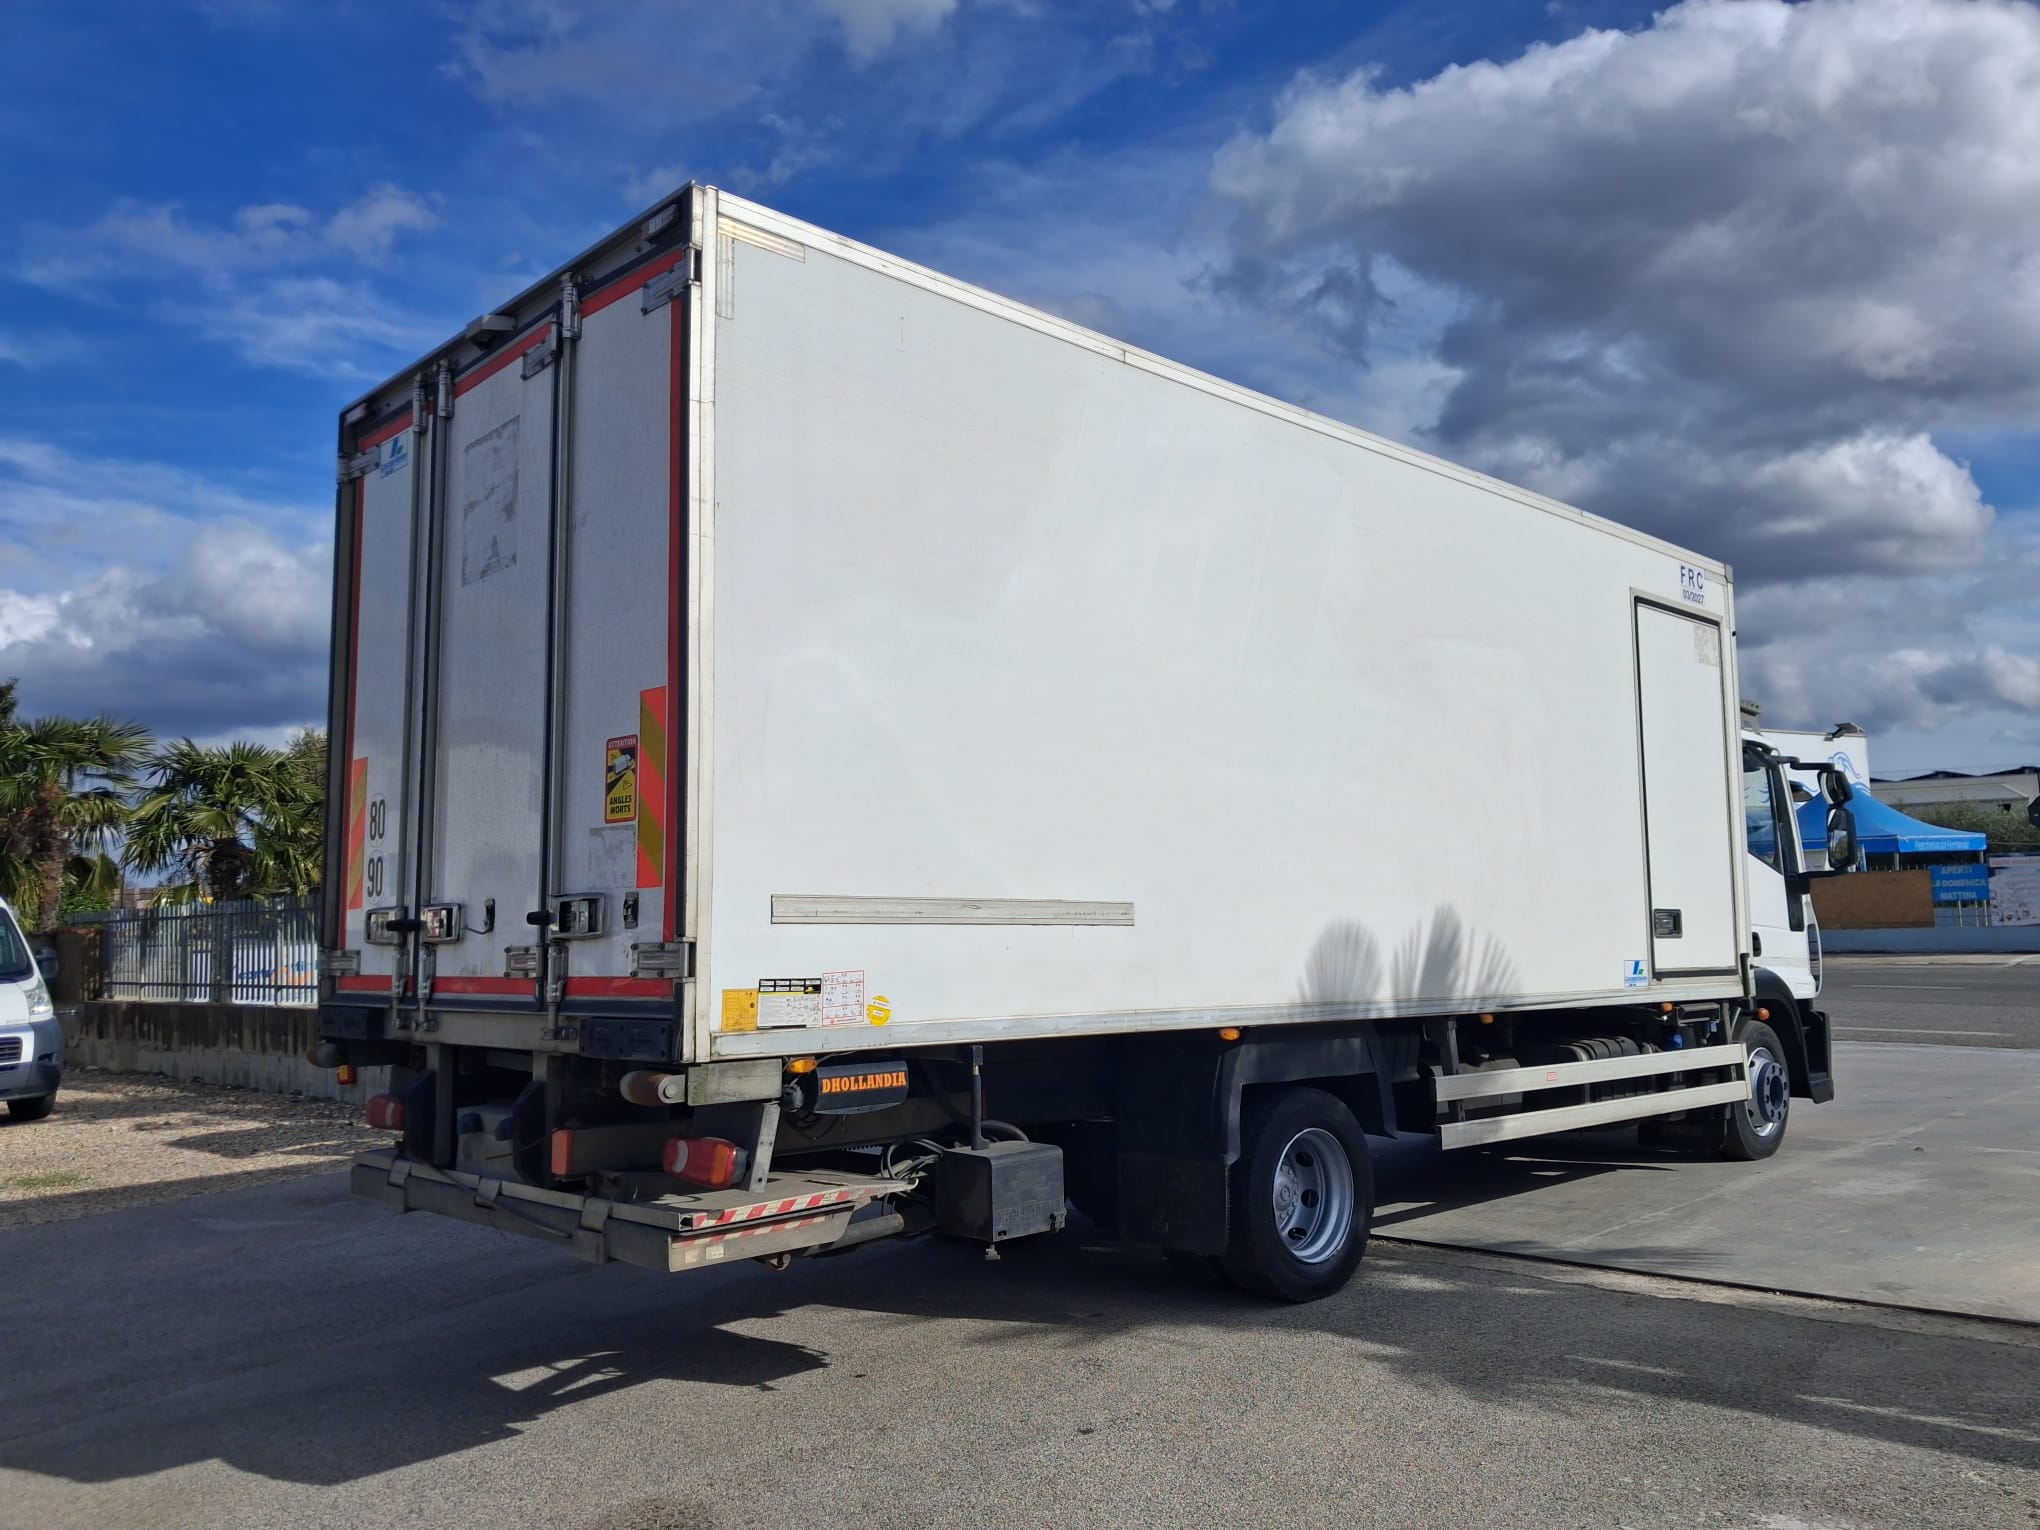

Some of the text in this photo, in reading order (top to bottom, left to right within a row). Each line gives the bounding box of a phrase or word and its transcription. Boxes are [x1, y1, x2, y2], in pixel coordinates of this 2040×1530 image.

[608, 738, 637, 749] ATTENTION
[610, 795, 632, 805] ANGLES
[610, 805, 631, 815] MORTS
[370, 799, 385, 841] 80
[367, 856, 383, 897] 90
[1942, 878, 1987, 888] DOMENICA
[1940, 891, 1978, 900] MATTINA
[821, 1072, 907, 1093] DHOLLANDIA
